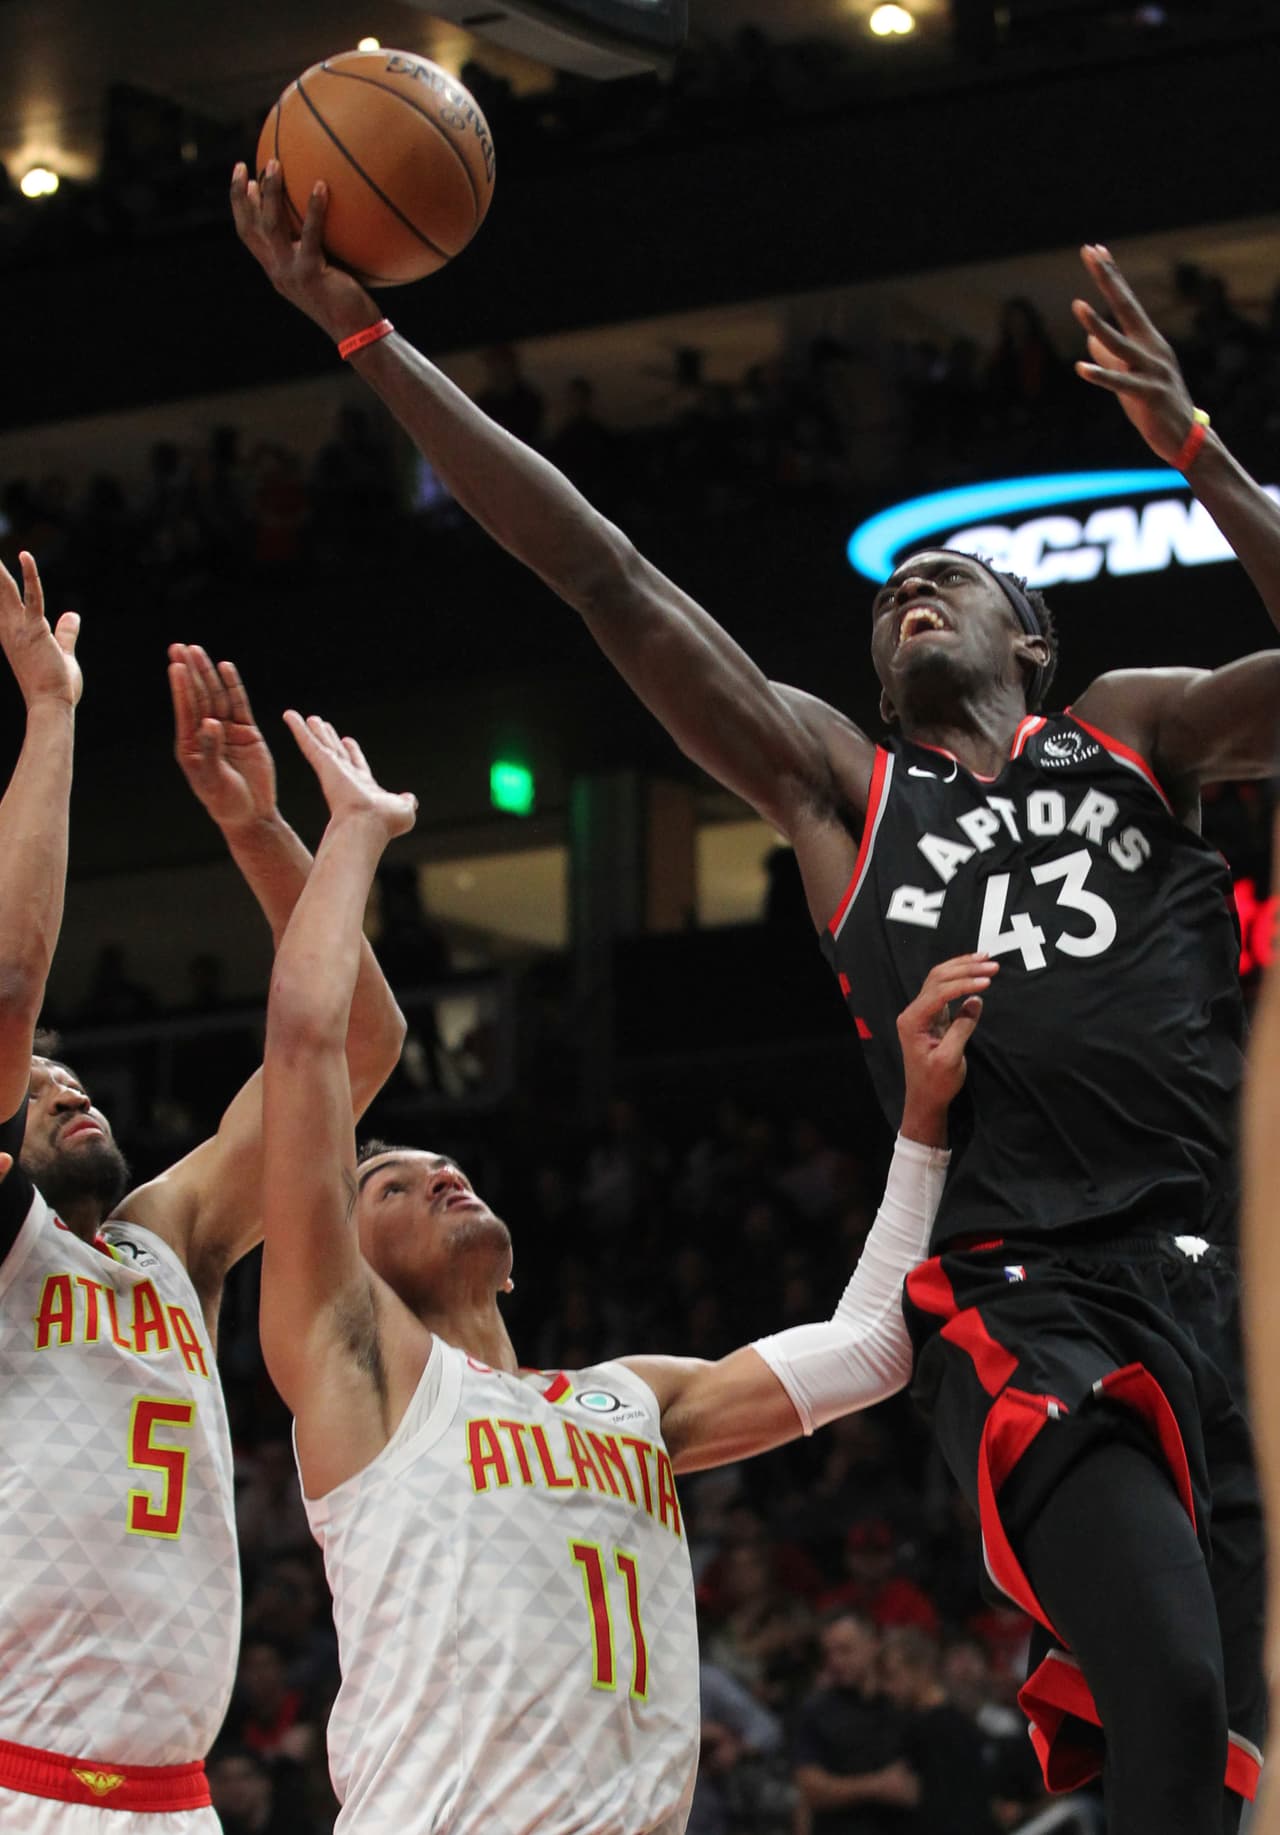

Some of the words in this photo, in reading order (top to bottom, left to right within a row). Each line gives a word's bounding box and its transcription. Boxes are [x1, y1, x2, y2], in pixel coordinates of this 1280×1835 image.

[1040, 757, 1071, 768] Sun
[1073, 744, 1100, 763] Life
[885, 787, 1151, 929] RAPTORS
[977, 848, 1118, 972] 43
[126, 1394, 197, 1541] 5
[464, 1416, 684, 1542] ATLANTA
[567, 1538, 650, 1703] 11
